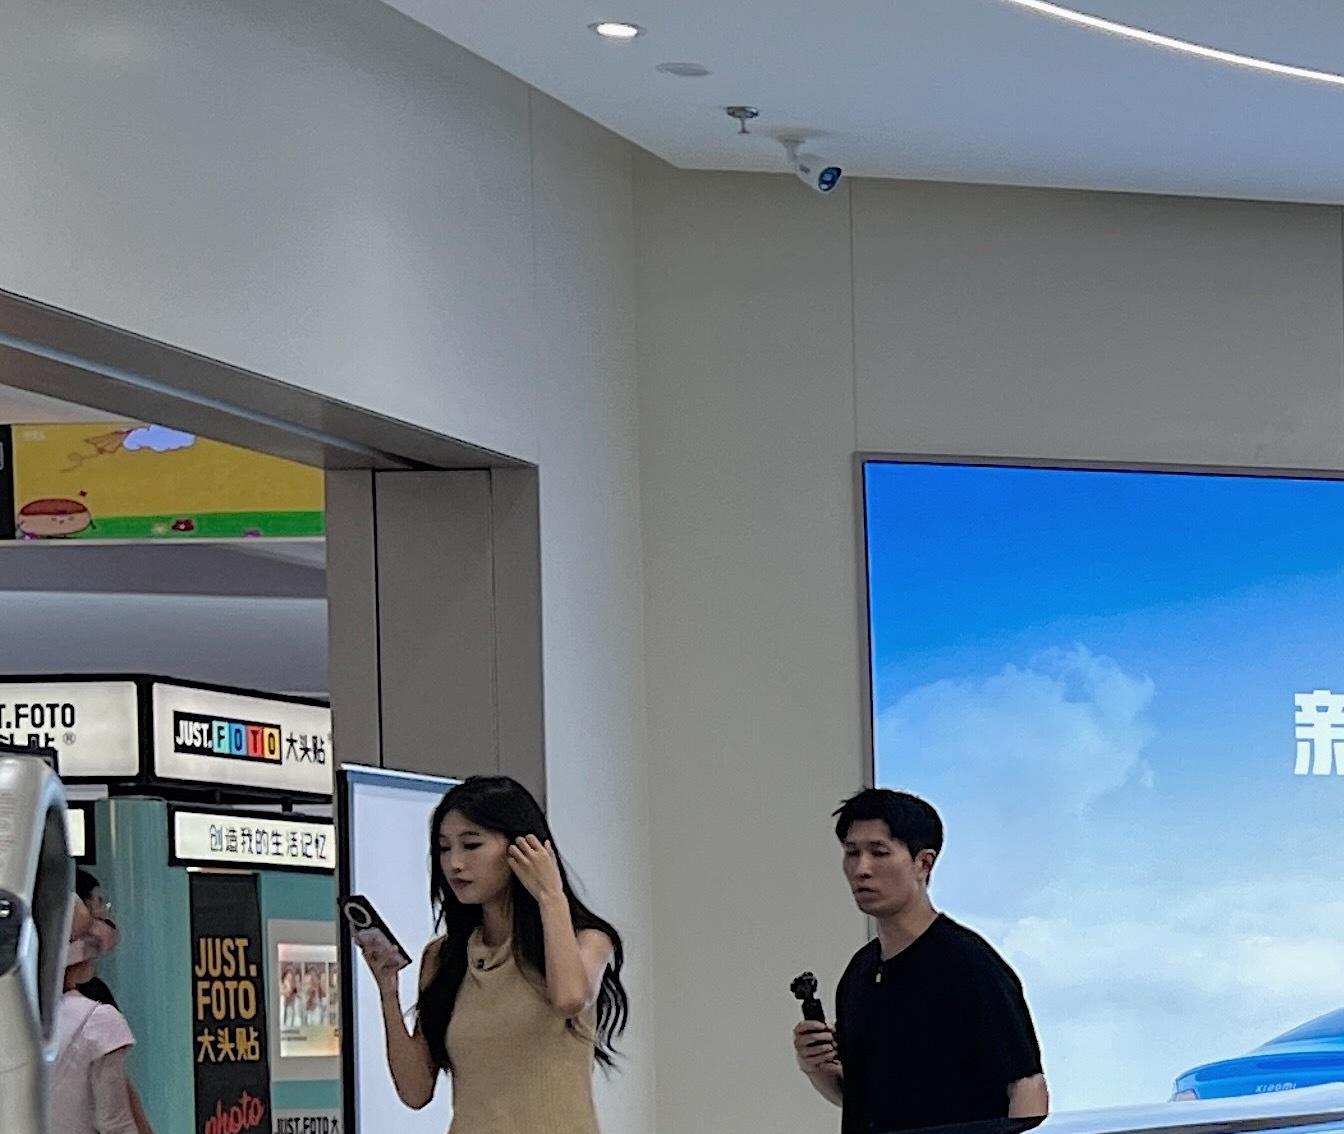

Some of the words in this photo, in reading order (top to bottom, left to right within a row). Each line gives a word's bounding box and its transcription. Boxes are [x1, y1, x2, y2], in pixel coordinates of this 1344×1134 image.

[285, 731, 326, 765] 大头贴
[209, 824, 327, 860] 创造我的生活记忆
[195, 937, 258, 978] JUST.
[197, 979, 257, 1021] FOTO
[197, 1026, 260, 1063] 大头贴
